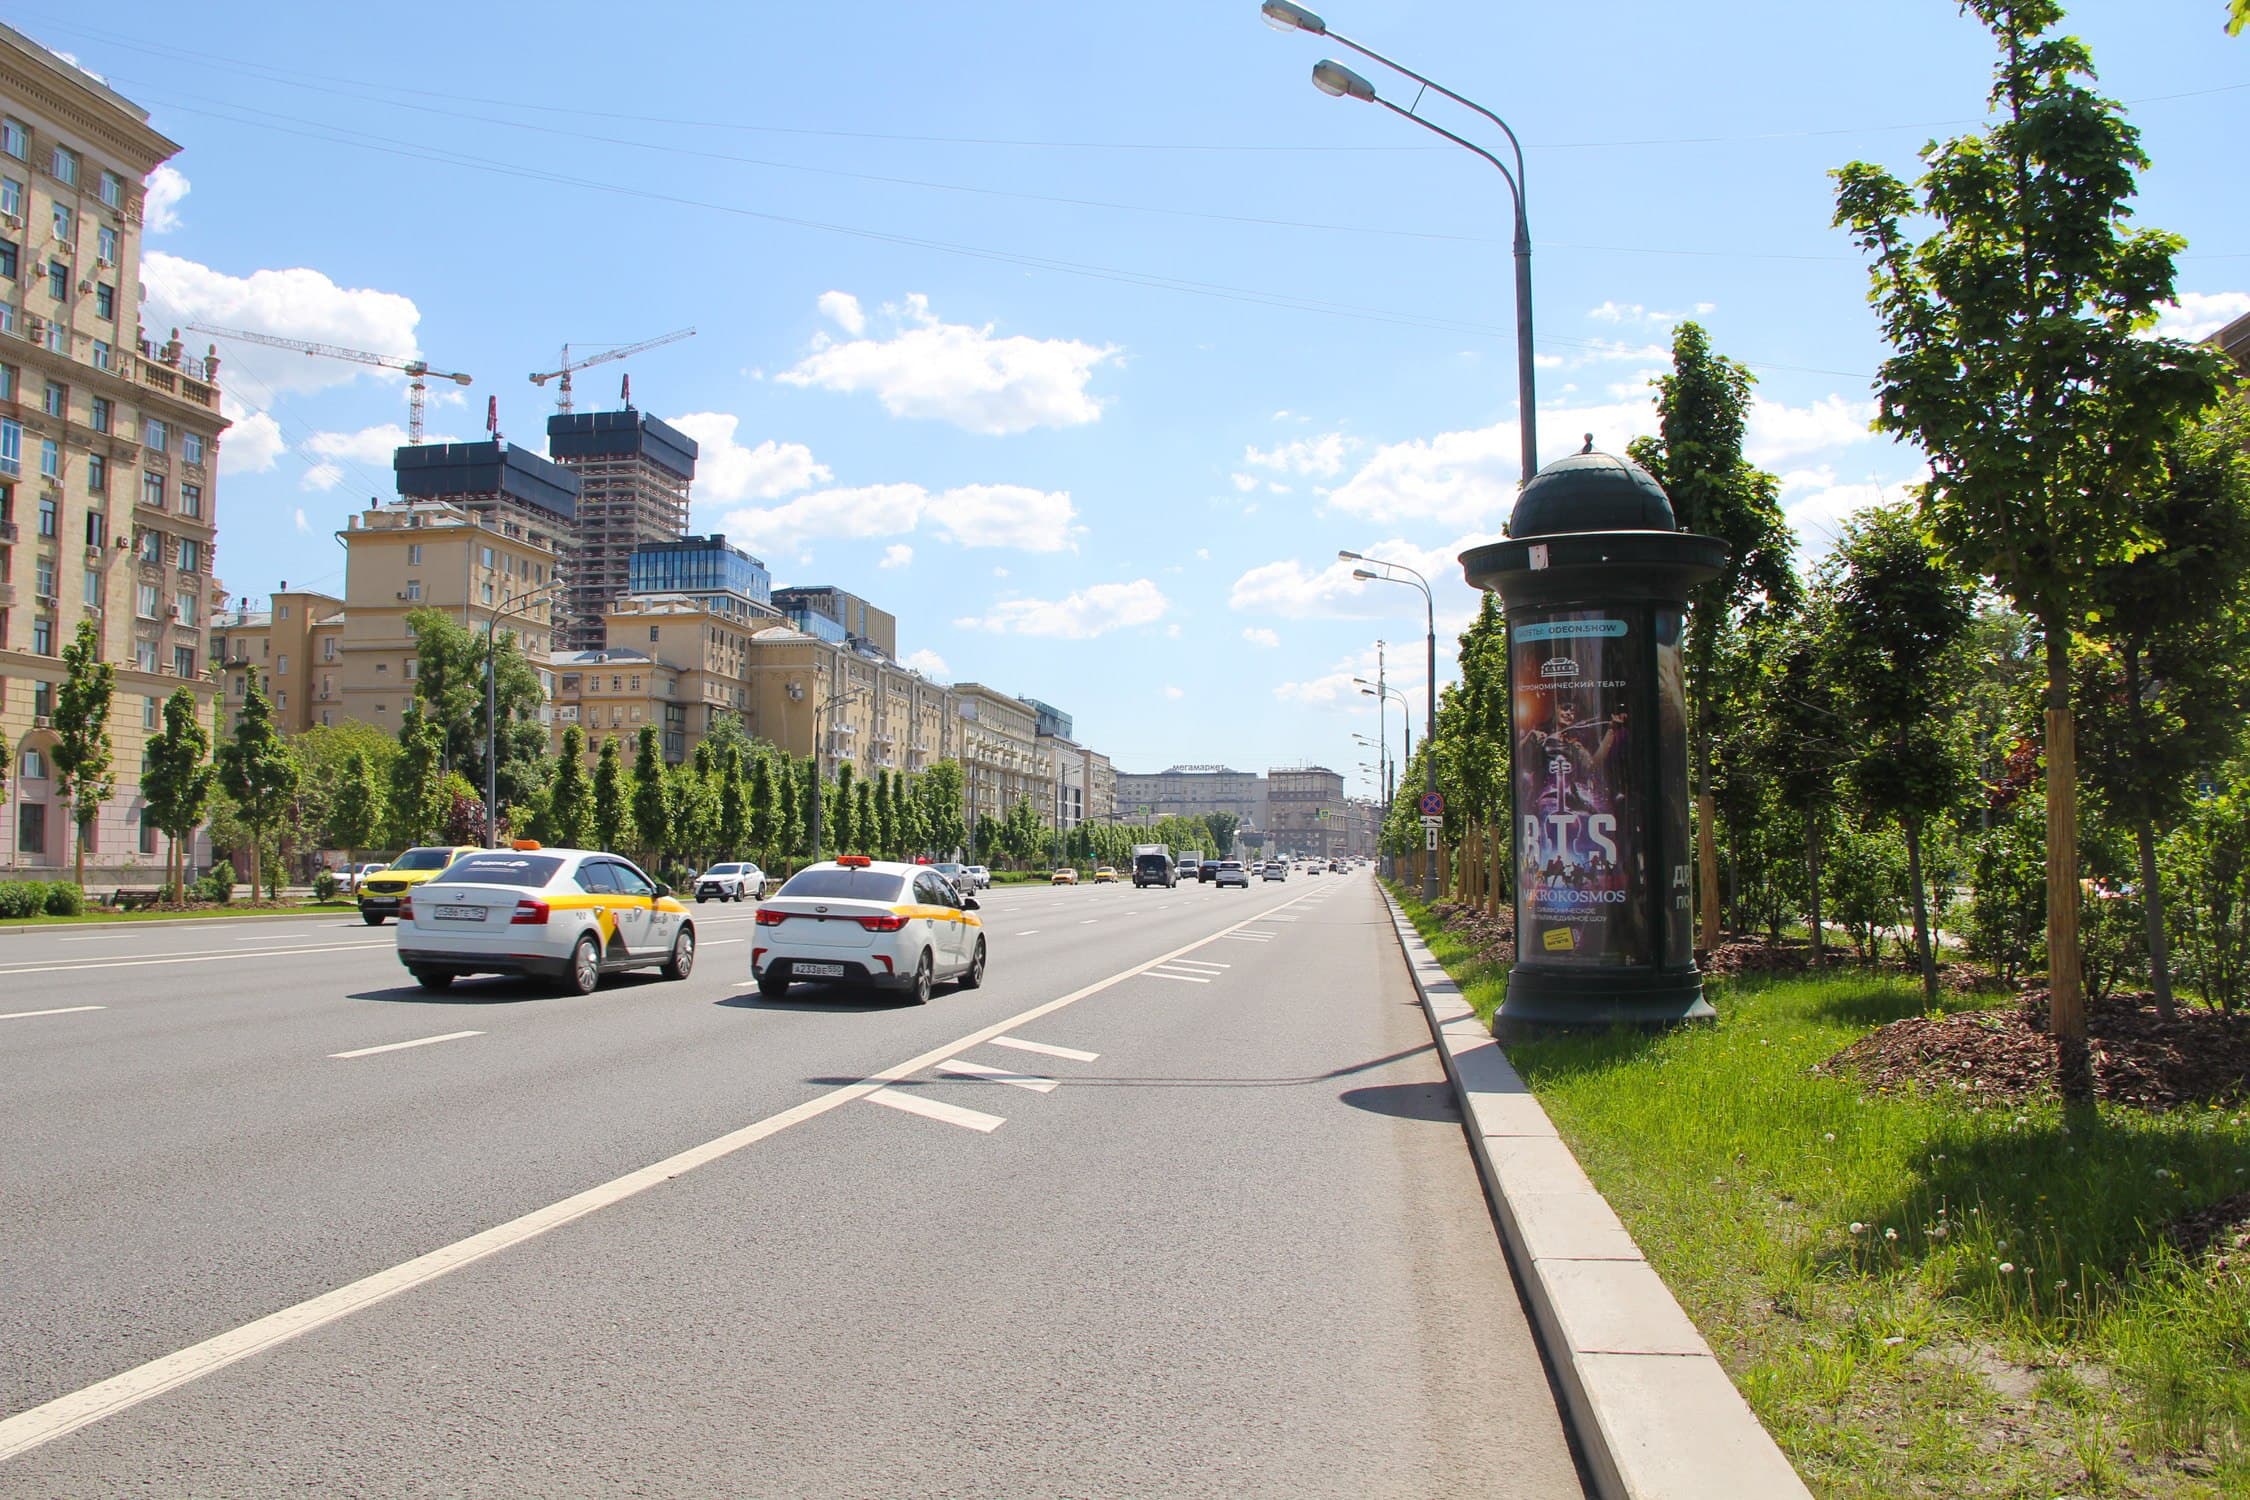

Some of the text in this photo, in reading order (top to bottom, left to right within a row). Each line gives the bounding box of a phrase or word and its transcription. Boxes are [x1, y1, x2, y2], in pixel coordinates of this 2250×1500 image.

[1548, 624, 1617, 634] ODEON.SHOW
[1597, 680, 1627, 688] ТЕАТР
[1523, 814, 1617, 866] BTS
